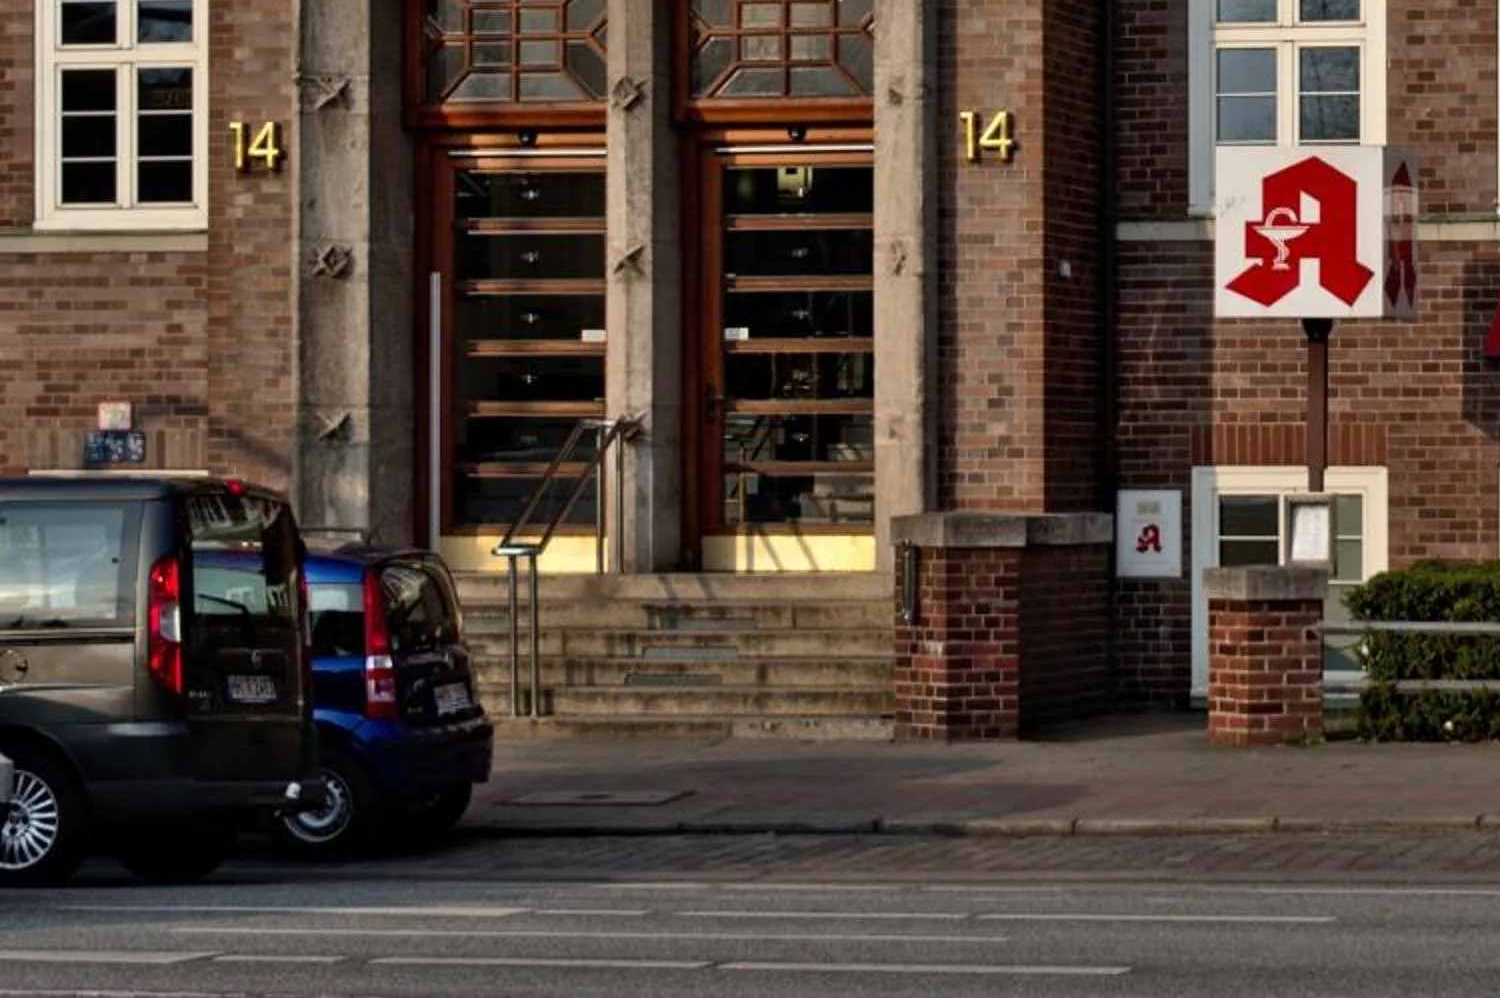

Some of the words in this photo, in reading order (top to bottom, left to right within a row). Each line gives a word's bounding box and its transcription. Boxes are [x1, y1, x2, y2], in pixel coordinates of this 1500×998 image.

[228, 121, 280, 169] 14
[960, 110, 1015, 160] 14
[1224, 155, 1376, 308] A
